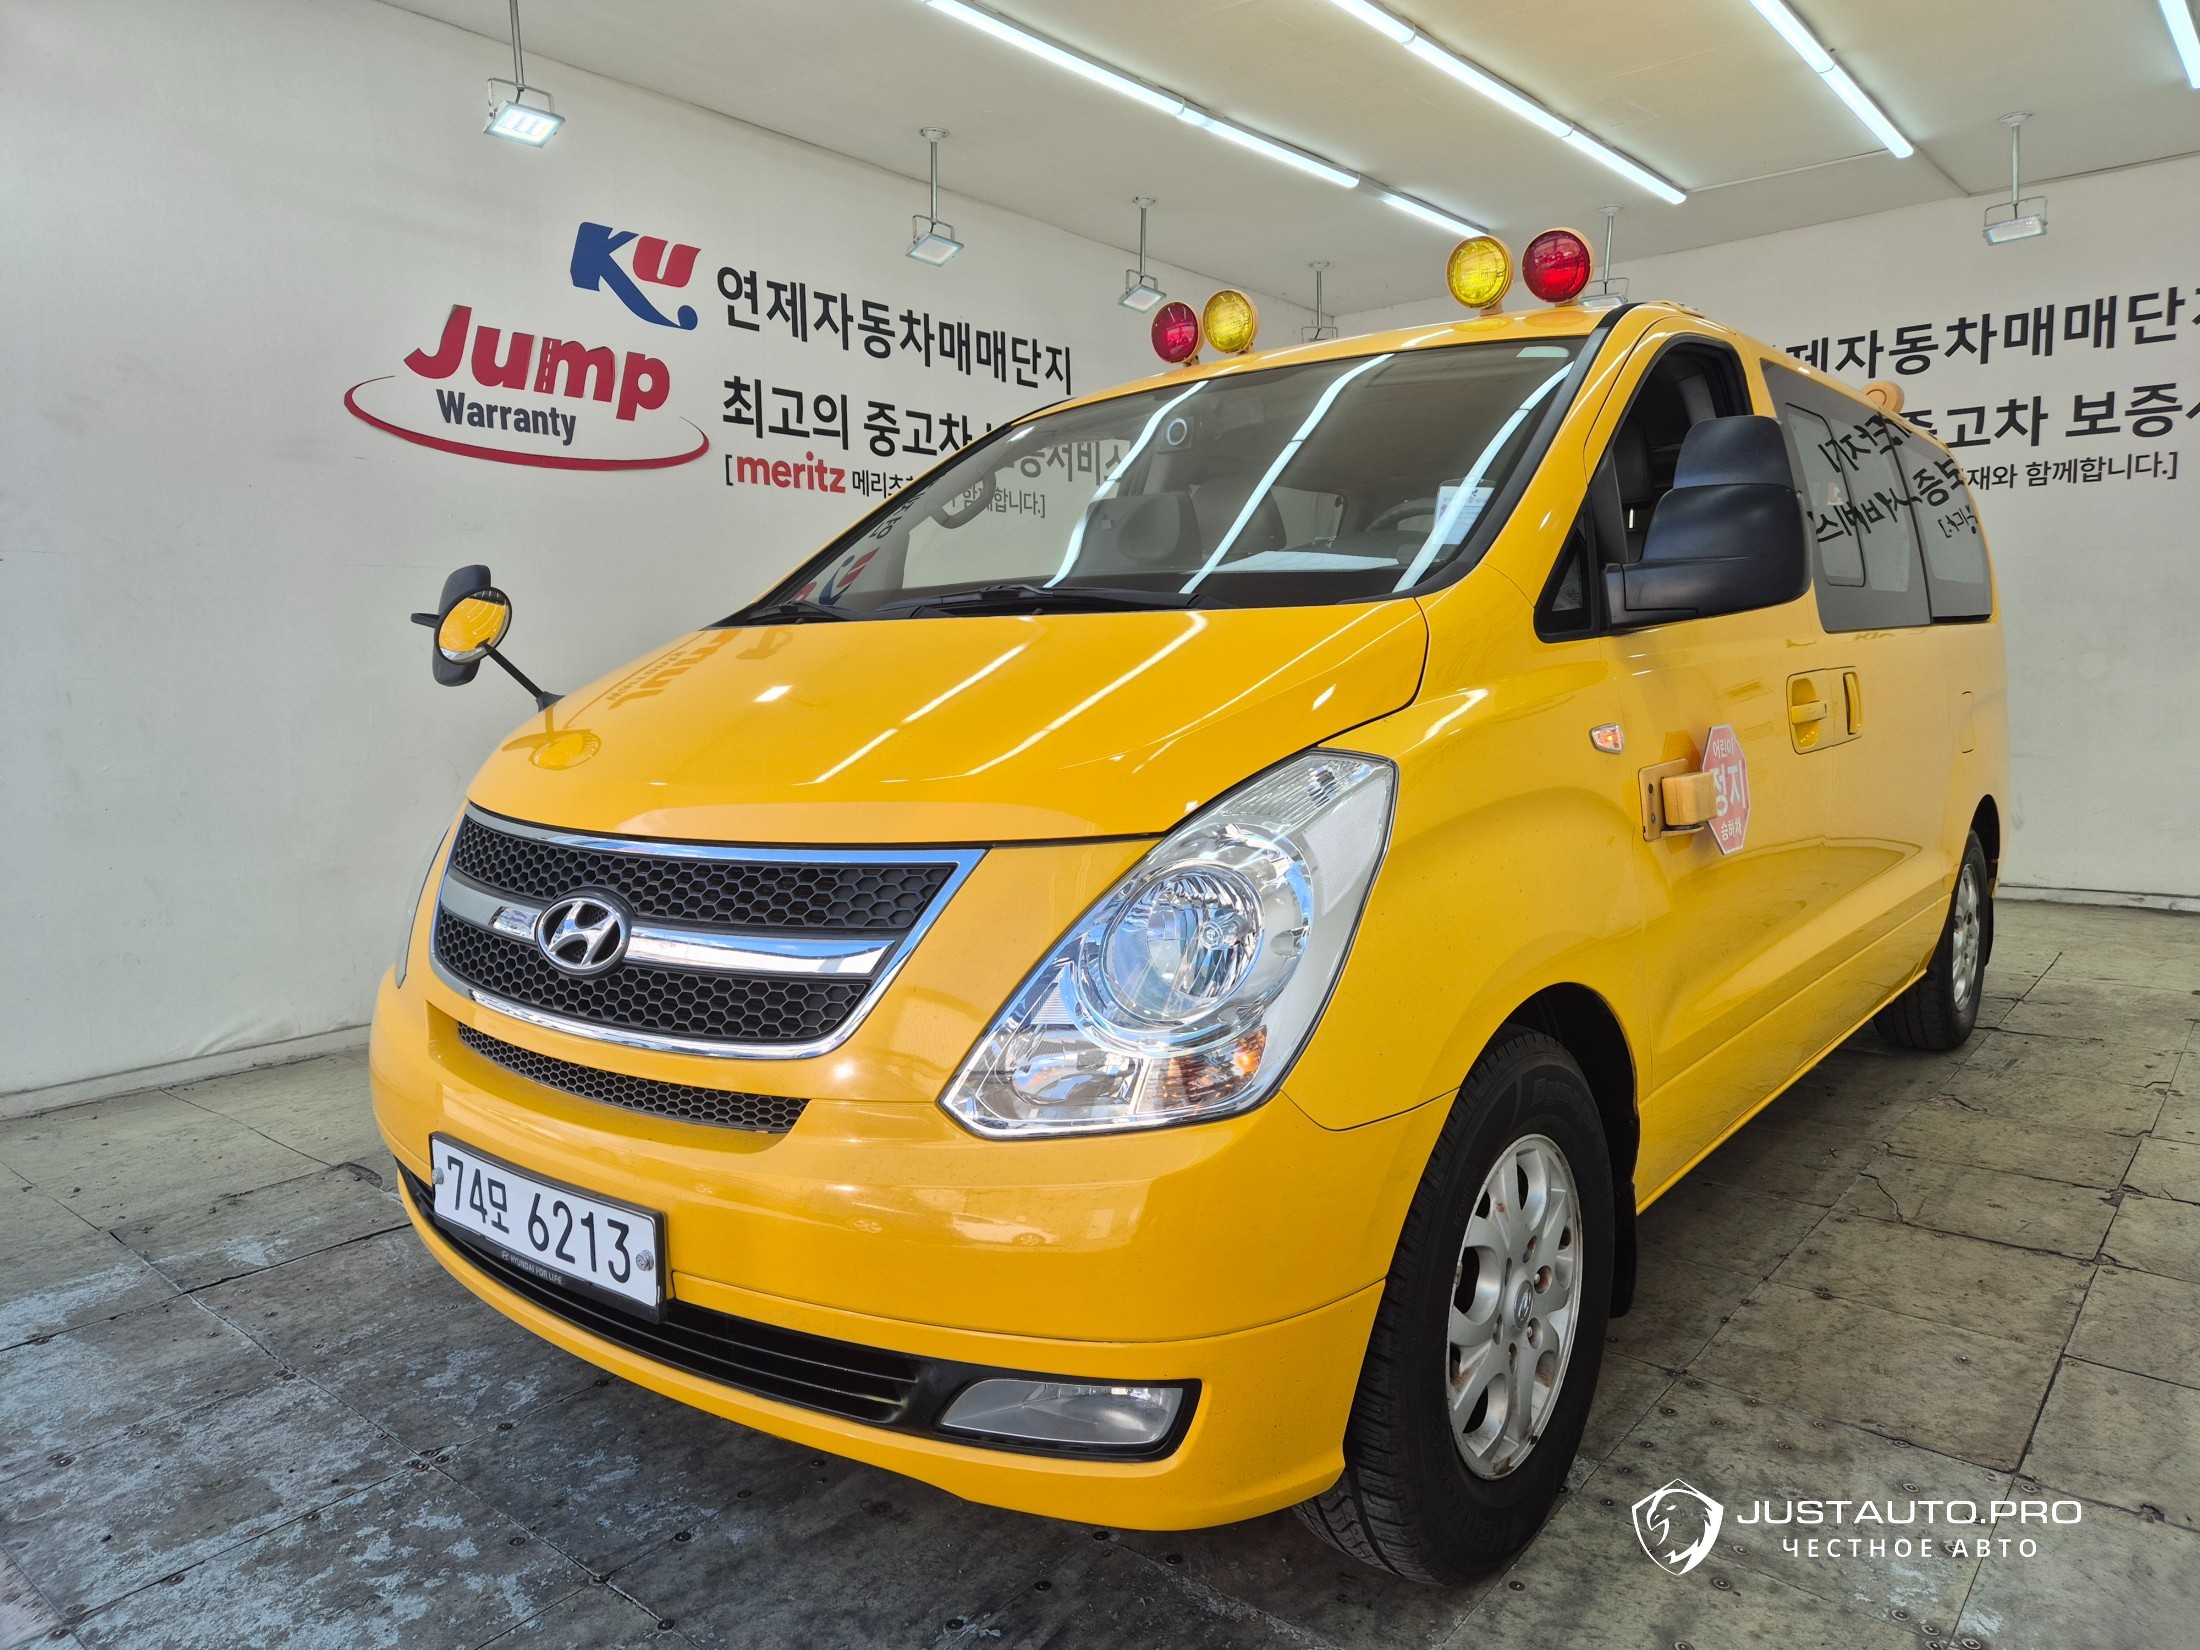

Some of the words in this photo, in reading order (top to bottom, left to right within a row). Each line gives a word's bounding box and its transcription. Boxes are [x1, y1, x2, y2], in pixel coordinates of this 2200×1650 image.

[403, 304, 670, 422] Jump
[717, 266, 1072, 395] 연제자동차매매단지
[1785, 286, 2200, 379] 제자동차매매단
[435, 388, 577, 446] Warranty
[722, 376, 850, 450] 최고의
[863, 400, 973, 457] 중고차
[1962, 463, 2018, 491] 재와
[1712, 736, 1735, 759] 어린이
[1709, 759, 1747, 817] 정지
[447, 1154, 510, 1234] 74모
[527, 1192, 631, 1284] 6213
[510, 1254, 535, 1272] HYUNDAI
[535, 1266, 548, 1279] FOR
[548, 1273, 562, 1285] LIFE
